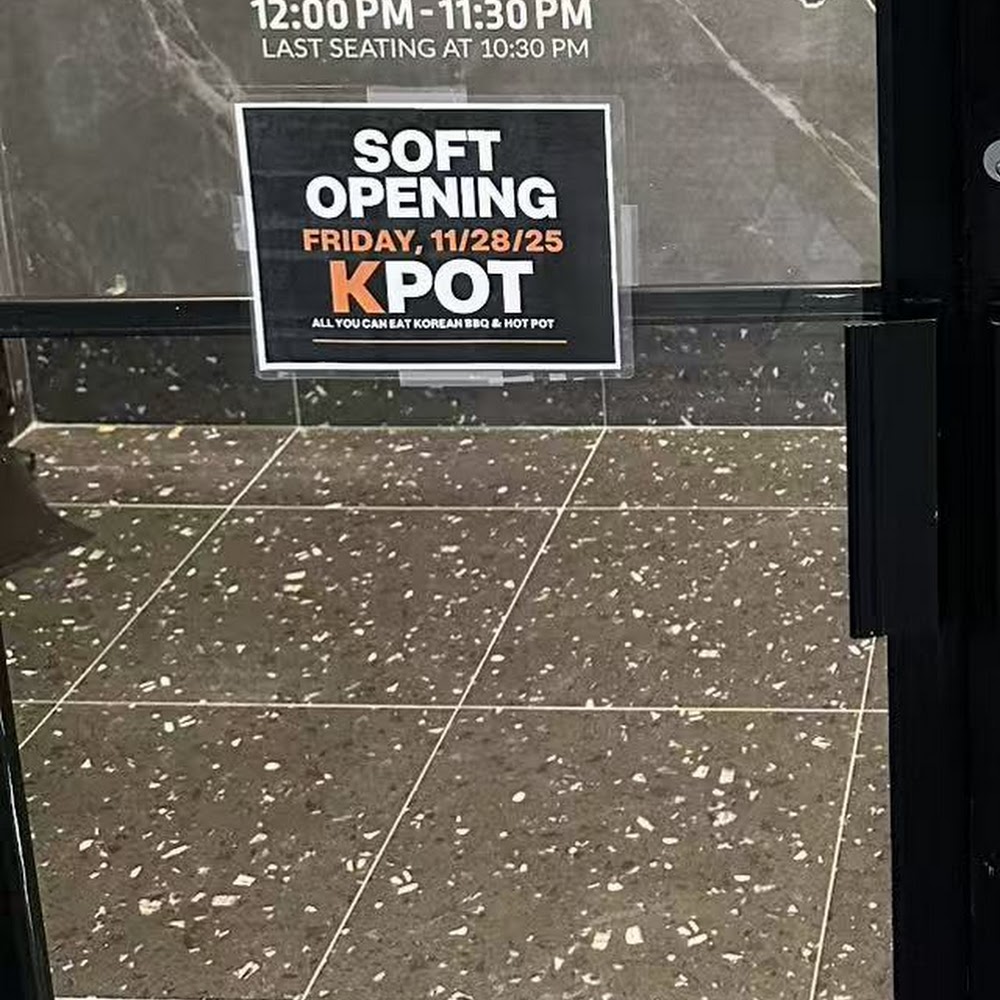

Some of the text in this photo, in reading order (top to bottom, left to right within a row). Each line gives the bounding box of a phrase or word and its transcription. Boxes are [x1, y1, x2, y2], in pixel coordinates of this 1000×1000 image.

[261, 37, 589, 59] LAST SEATING AT 10:30 PM
[353, 128, 501, 173] SOFT
[305, 175, 558, 219] OPENING
[302, 229, 564, 255] FRIDAY, 11/28/25
[329, 258, 535, 315] KPOT
[312, 318, 555, 329] ALL YOU CAN EAT KOREAN BBQ & HOT POT
